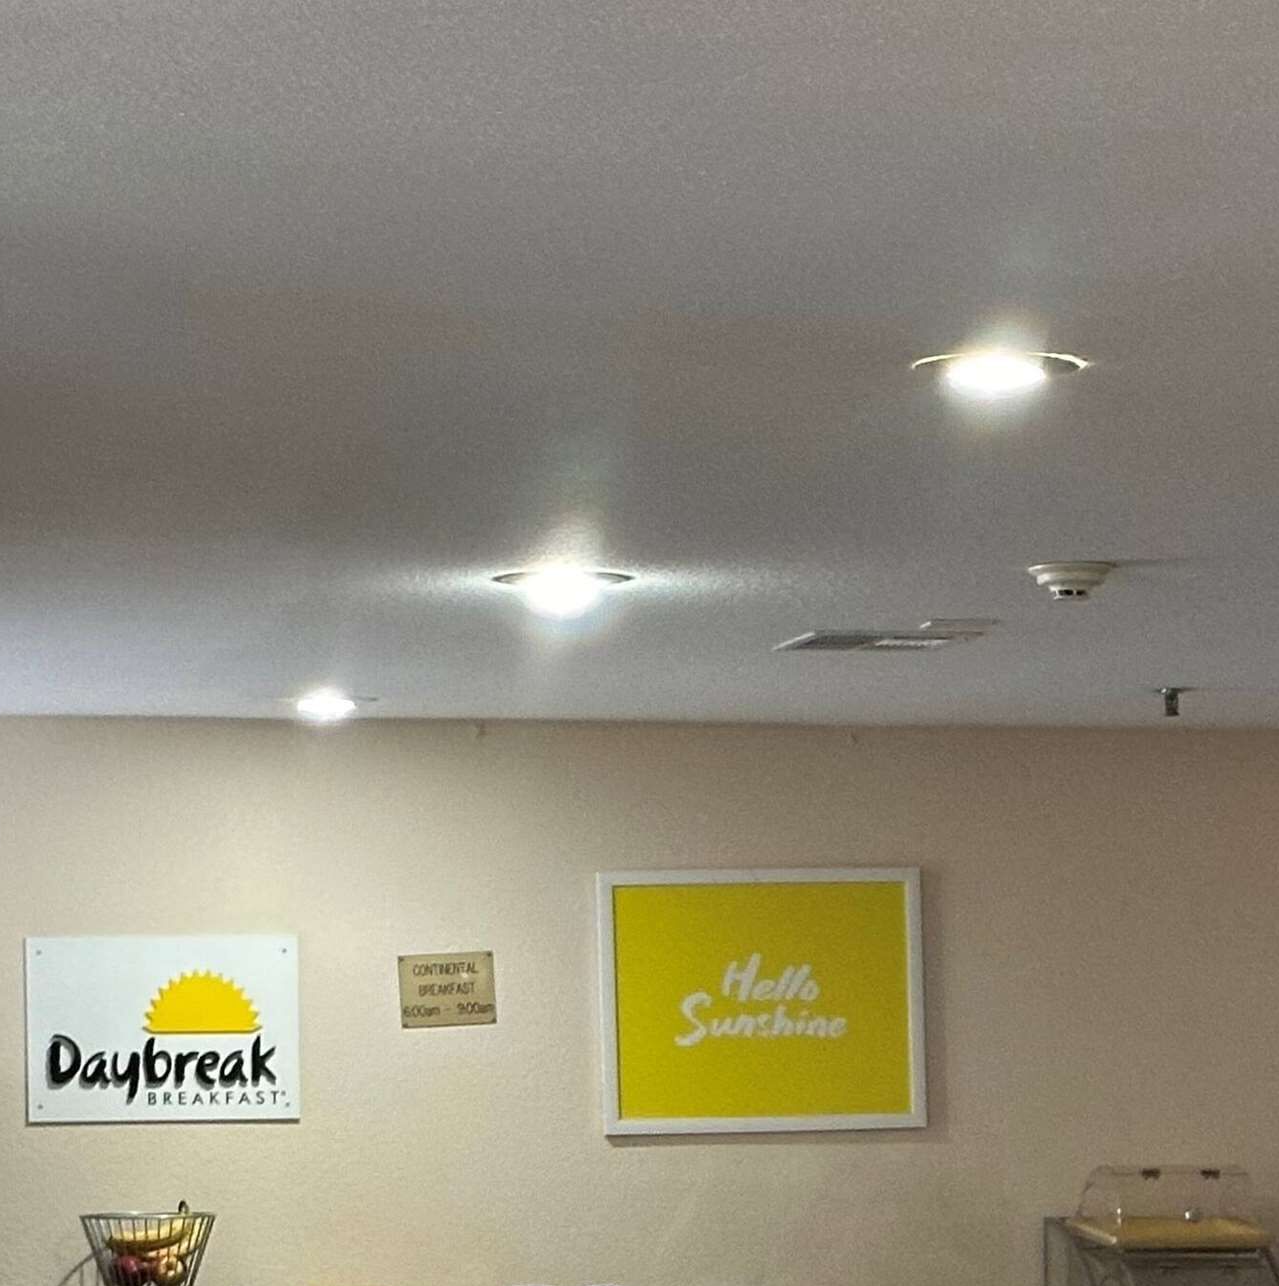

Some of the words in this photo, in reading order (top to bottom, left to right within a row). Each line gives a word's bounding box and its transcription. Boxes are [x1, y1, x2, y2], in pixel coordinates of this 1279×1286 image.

[412, 961, 479, 976] CONTINENTAL
[721, 952, 820, 1002] Hello
[418, 982, 475, 997] BREAKFAST
[674, 991, 847, 1047] Sunshine
[46, 1034, 277, 1105] Daybreak
[147, 1090, 281, 1106] BREAKFAST
